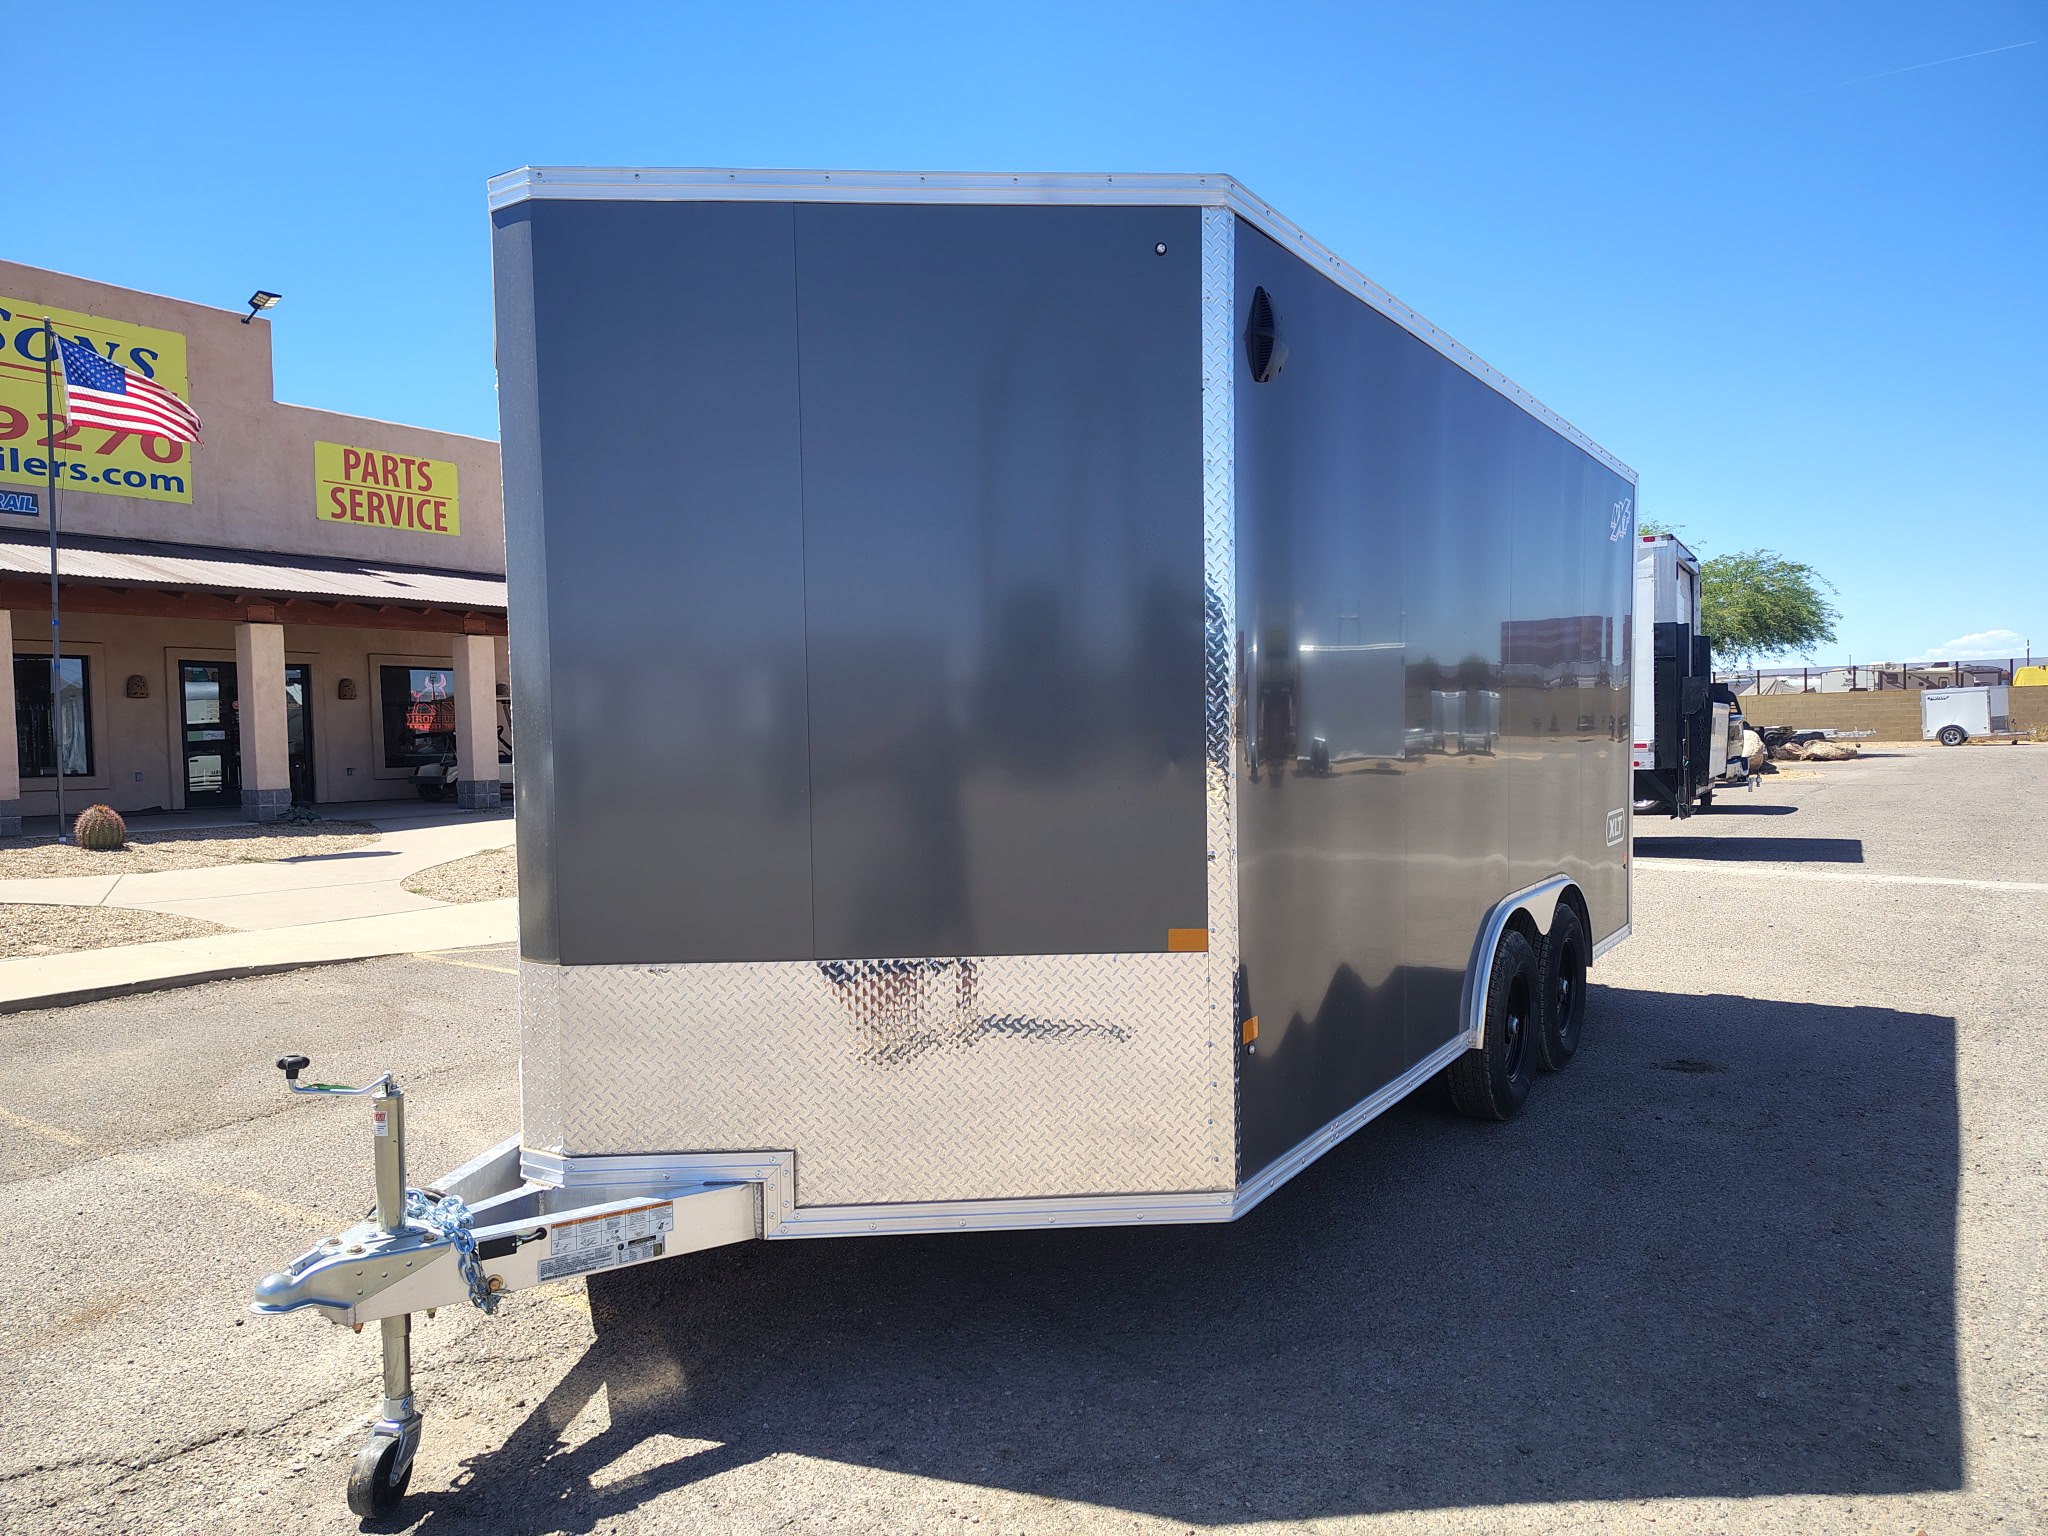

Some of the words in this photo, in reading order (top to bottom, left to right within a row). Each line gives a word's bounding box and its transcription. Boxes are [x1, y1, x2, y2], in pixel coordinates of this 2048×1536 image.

[343, 448, 432, 492] PARTS
[330, 486, 448, 532] SERVICE
[1609, 816, 1623, 839] XLT
